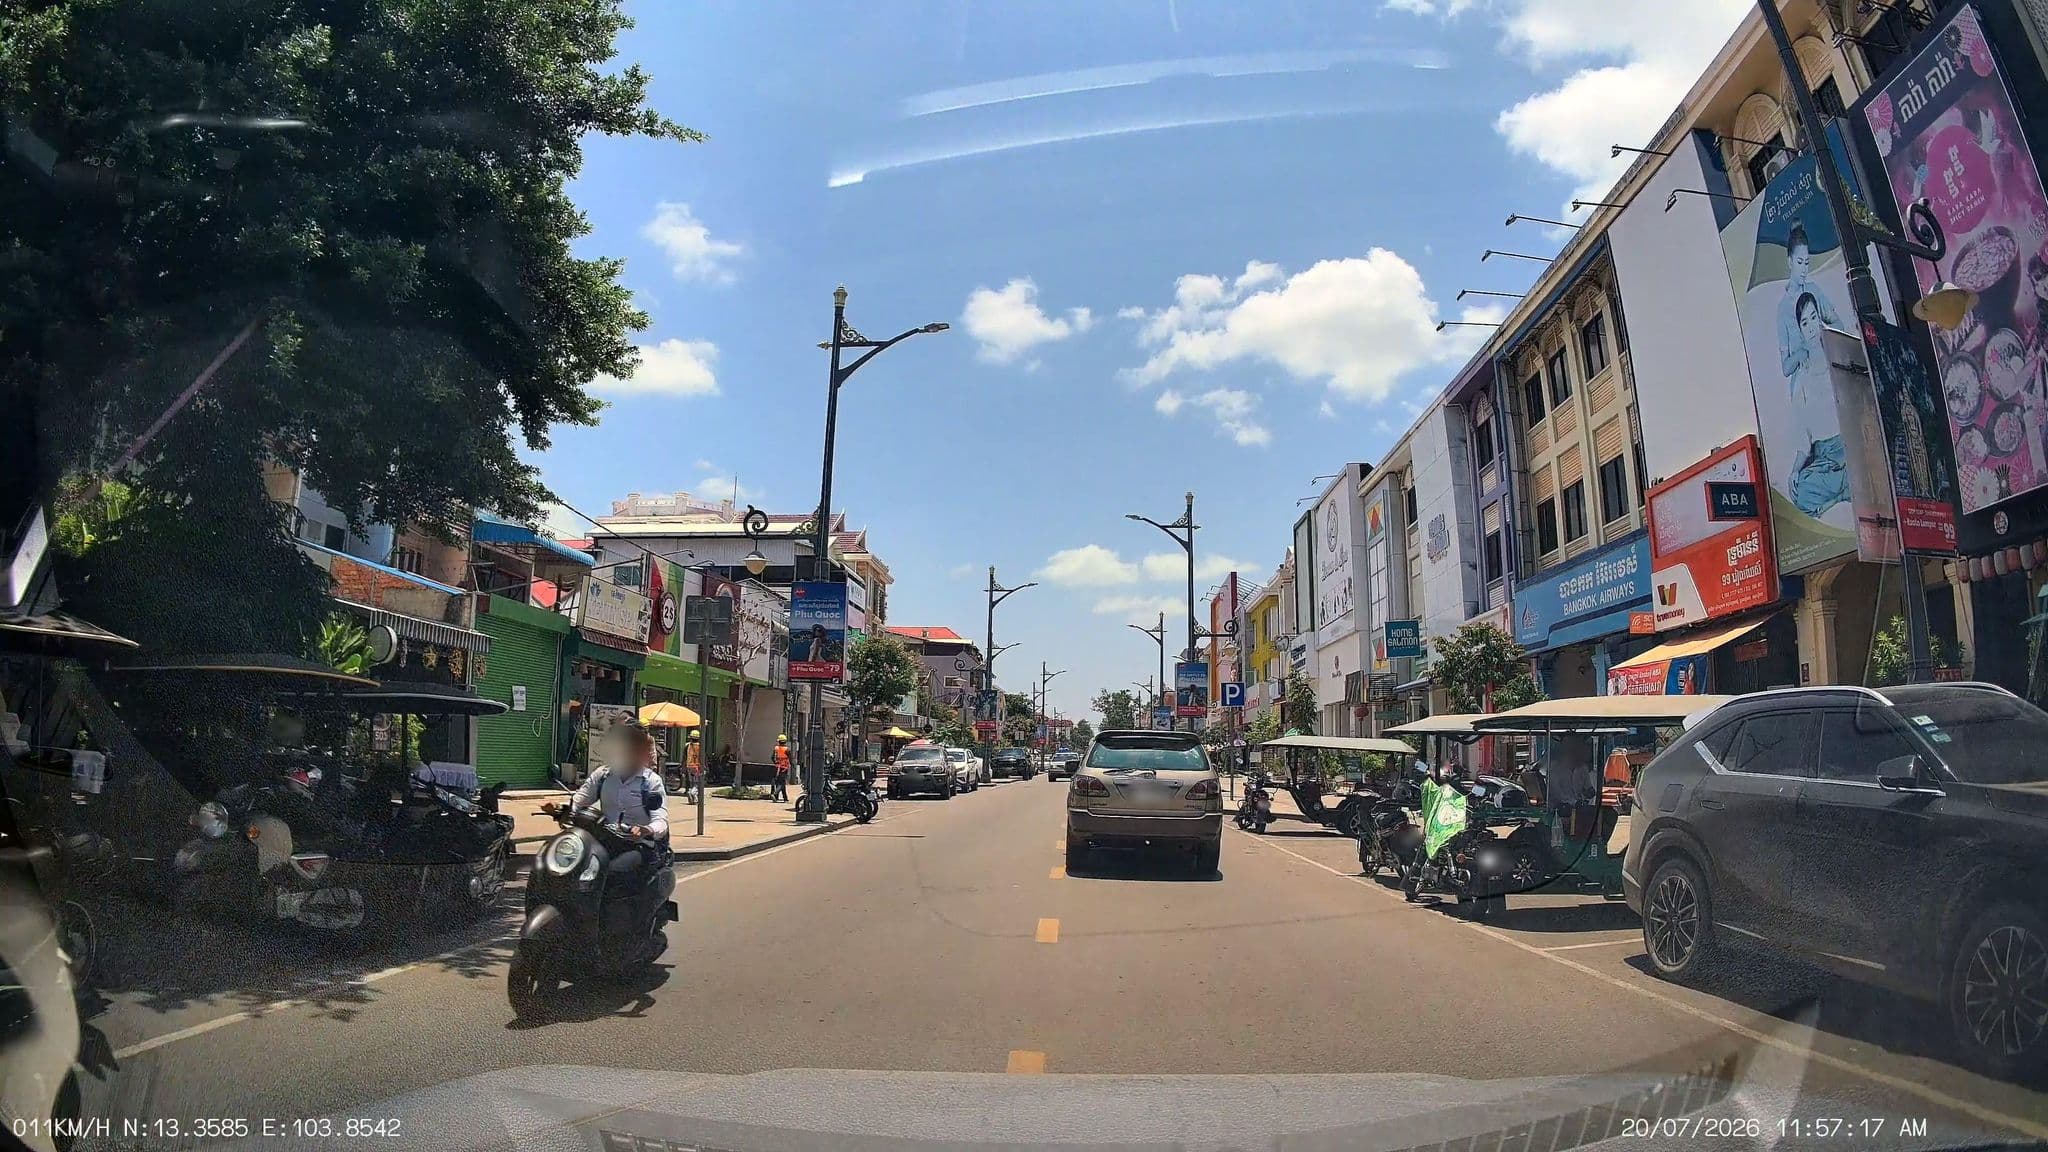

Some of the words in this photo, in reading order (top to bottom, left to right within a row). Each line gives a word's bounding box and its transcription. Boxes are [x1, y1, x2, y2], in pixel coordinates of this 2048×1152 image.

[1721, 493, 1749, 506] ABA
[1943, 522, 1955, 540] 99
[1563, 593, 1598, 616] BANGKOK
[1599, 581, 1635, 605] AIRWAYS
[794, 610, 812, 618] Phu
[1387, 637, 1418, 646] SALMON
[830, 664, 840, 672] 79
[1225, 683, 1240, 705] P
